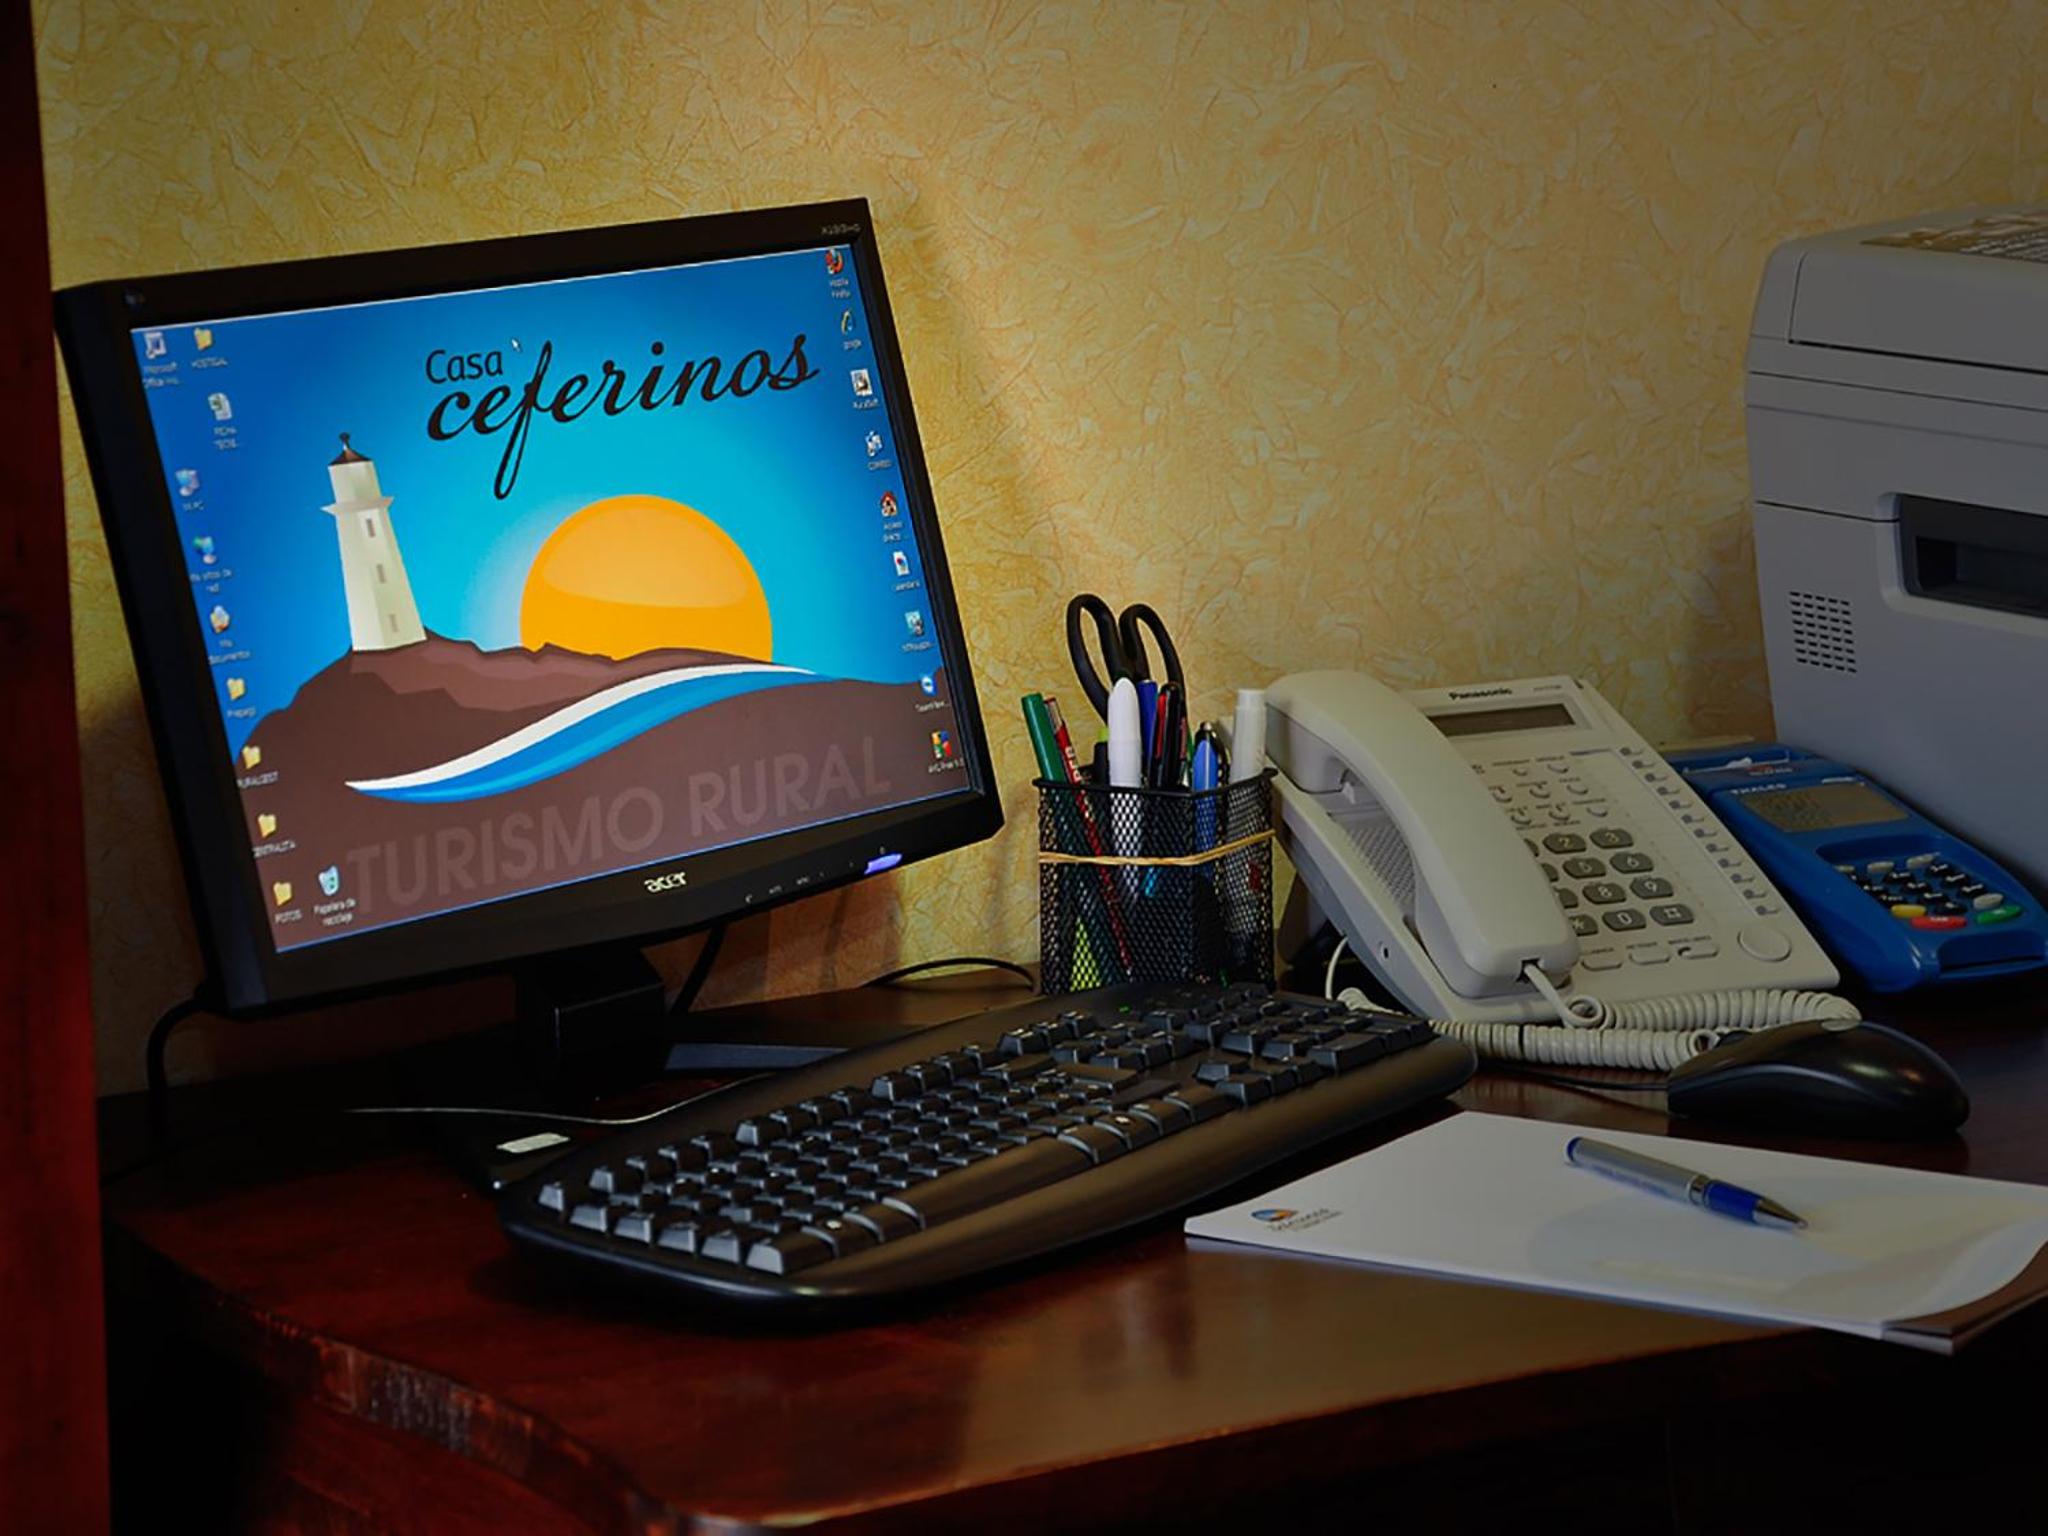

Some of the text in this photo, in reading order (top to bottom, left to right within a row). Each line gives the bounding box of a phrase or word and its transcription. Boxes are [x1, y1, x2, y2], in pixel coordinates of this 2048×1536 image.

[425, 349, 504, 384] Casa
[427, 333, 820, 501] ceferinos
[1449, 687, 1513, 701] Panasonic
[346, 736, 893, 912] TURISMO RURAL
[643, 869, 687, 895] acer
[1617, 911, 1633, 925] 0
